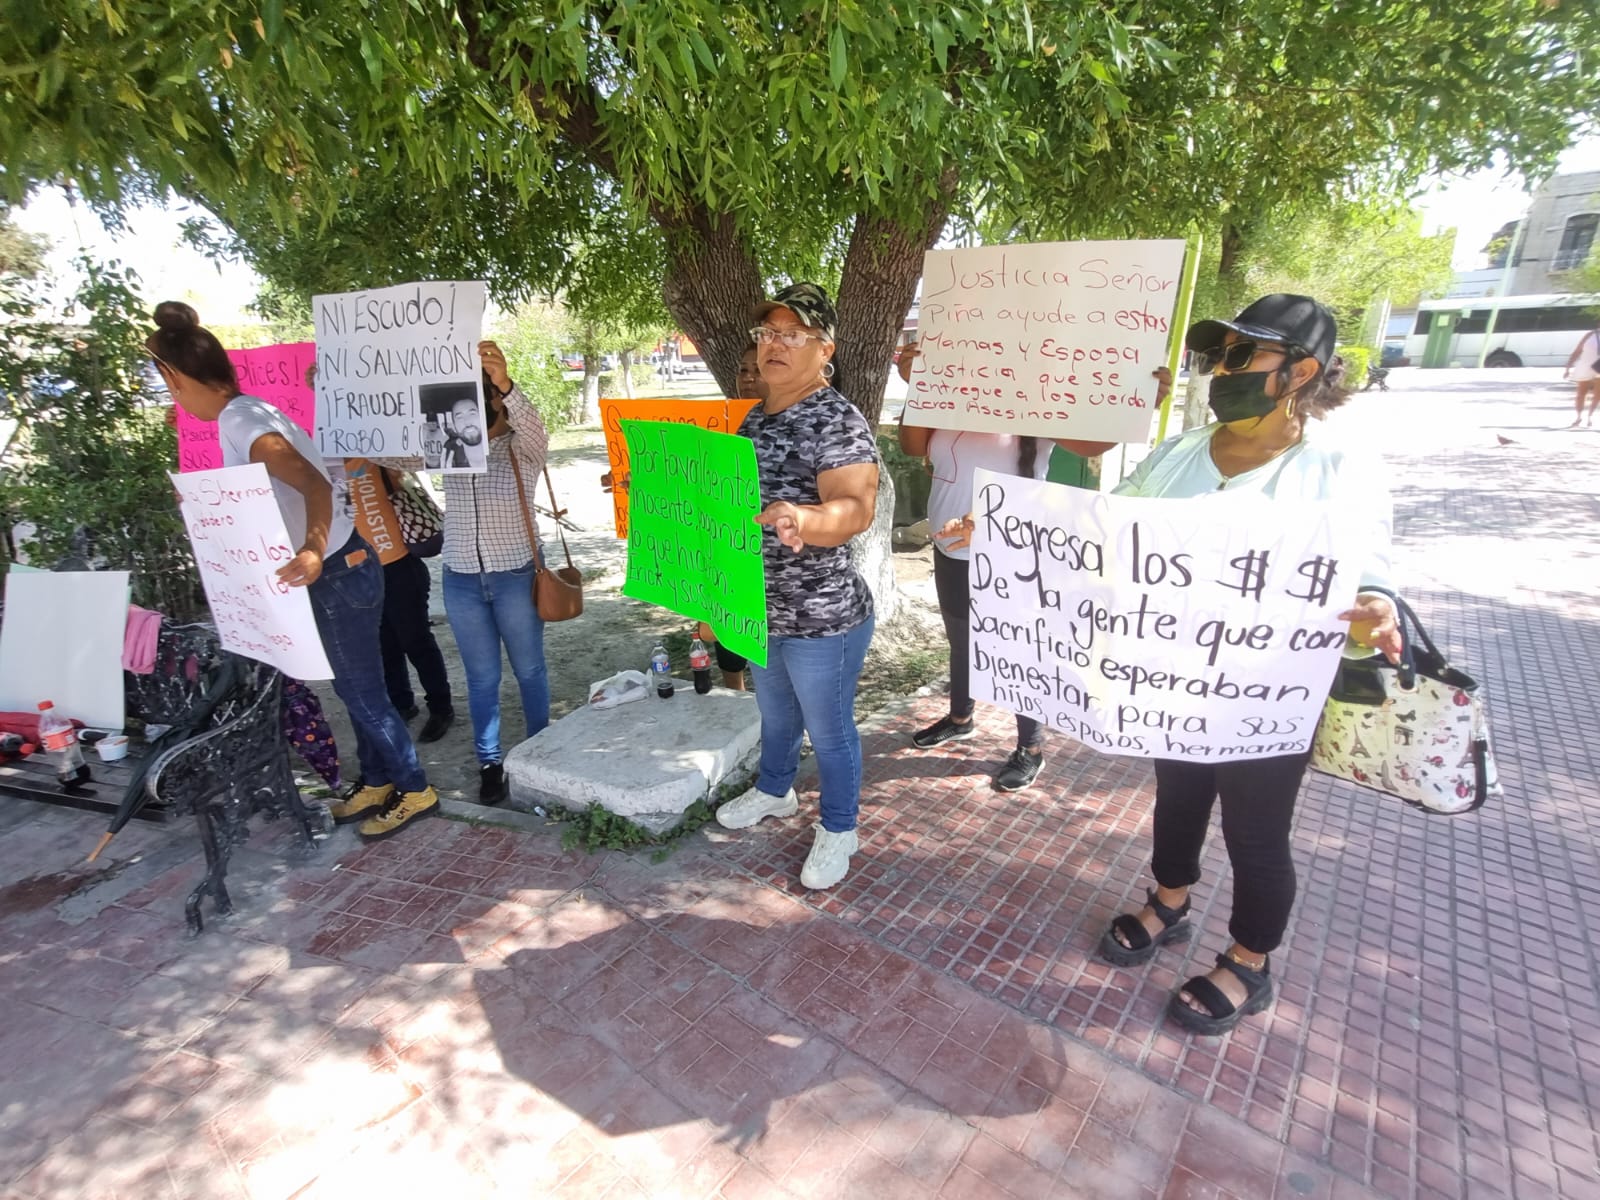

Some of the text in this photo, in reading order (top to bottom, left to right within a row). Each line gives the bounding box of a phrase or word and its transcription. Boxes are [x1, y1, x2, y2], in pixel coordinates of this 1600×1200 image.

[928, 253, 1174, 298] Justicia Señor
[997, 299, 1079, 331] ayude
[1087, 309, 1106, 324] a
[1115, 300, 1168, 333] estas
[355, 333, 474, 379] SALVACIÓN
[919, 331, 1004, 356] Mamas
[912, 355, 1122, 387] Justicia que se
[915, 379, 1003, 401] entregue
[1016, 390, 1029, 402] a
[1041, 384, 1077, 405] los
[628, 425, 659, 475] Por
[358, 473, 394, 554] HOLLISTER
[979, 483, 1104, 583] Regresa
[1131, 521, 1194, 588] los
[646, 534, 674, 569] que
[971, 552, 1346, 667] De la gente que con
[973, 640, 1101, 713] bienestar
[1117, 703, 1208, 735] para
[1099, 656, 1311, 702] esperaban
[1164, 733, 1307, 757] hermanos
